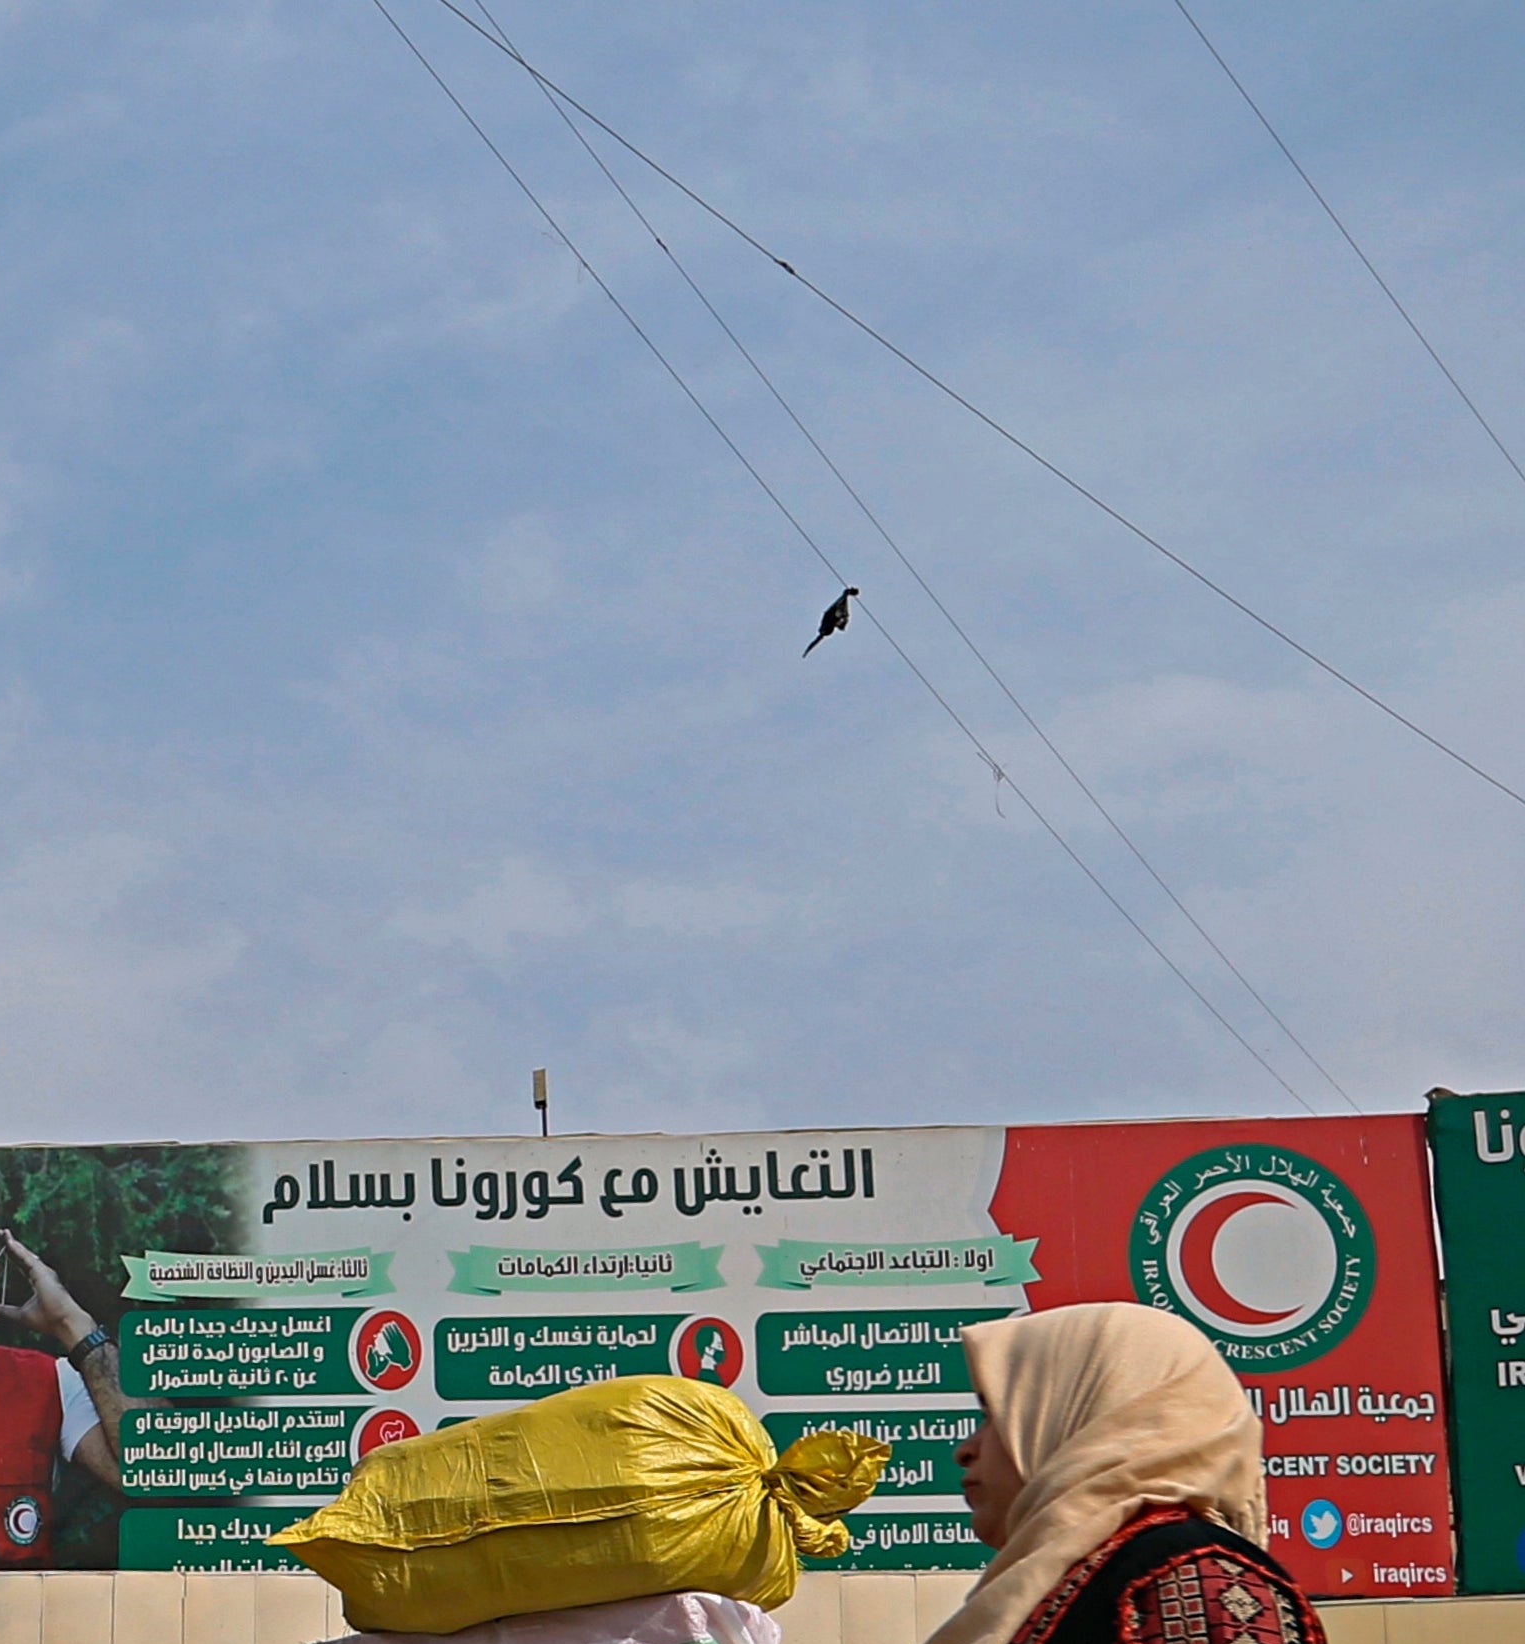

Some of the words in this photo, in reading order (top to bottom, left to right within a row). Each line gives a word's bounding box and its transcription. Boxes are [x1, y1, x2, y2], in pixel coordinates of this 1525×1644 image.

[263, 1159, 416, 1225] بسلام
[431, 1156, 584, 1220] كورونا
[600, 1167, 658, 1218] مع
[674, 1147, 875, 1216] التعايش
[149, 1261, 204, 1286] الشخصية
[207, 1260, 253, 1282] النظافة
[265, 1259, 304, 1286] اليدين
[498, 1256, 578, 1277] الكمامات
[800, 1252, 885, 1281] الاجتماعي
[888, 1251, 950, 1272] التباعد
[1212, 1328, 1319, 1360] CRESCENT
[1318, 1254, 1362, 1334] SOCIETY
[134, 1318, 184, 1338] بالماء
[188, 1317, 226, 1340] جيدا
[230, 1316, 278, 1337] يديك
[281, 1315, 331, 1337] اغسل
[530, 1325, 592, 1346] نفسك
[596, 1325, 657, 1350] لحماية
[781, 1322, 855, 1352] المباشر
[861, 1322, 931, 1351] الاتصال
[192, 1341, 235, 1361] لمدة
[447, 1326, 509, 1353] الاخرين
[514, 1332, 525, 1351] و
[142, 1343, 190, 1366] لاتقل
[238, 1343, 310, 1364] الصابون
[313, 1346, 324, 1362] و
[149, 1368, 220, 1391] باستمرار
[226, 1367, 268, 1390] ثانية
[292, 1368, 318, 1391] عن
[489, 1364, 560, 1388] الكمامة
[825, 1363, 890, 1392] ضروري
[895, 1362, 942, 1391] الغير
[1270, 1386, 1351, 1424] الهلال
[1357, 1386, 1436, 1422] جمعية
[135, 1412, 151, 1434] او
[154, 1411, 211, 1436] الورقية
[214, 1411, 279, 1435] المناديل
[282, 1410, 346, 1435] استخدم
[907, 1417, 977, 1446] الابتعاد
[123, 1442, 186, 1465] العطاس
[189, 1442, 205, 1464] او
[208, 1441, 264, 1464] السعال
[266, 1440, 302, 1459] اثناء
[304, 1440, 347, 1464] الكوع
[1260, 1455, 1330, 1477] SCENT
[1336, 1453, 1436, 1476] SOCIETY
[121, 1469, 187, 1492] النفايات
[188, 1470, 227, 1492] كيس
[229, 1469, 254, 1497] في
[257, 1470, 294, 1487] منها
[296, 1468, 339, 1490] تخلص
[177, 1518, 216, 1546] جيدا
[879, 1523, 929, 1550] الامان
[1347, 1512, 1433, 1538] @iraqircs
[1372, 1562, 1447, 1588] iraqircs
